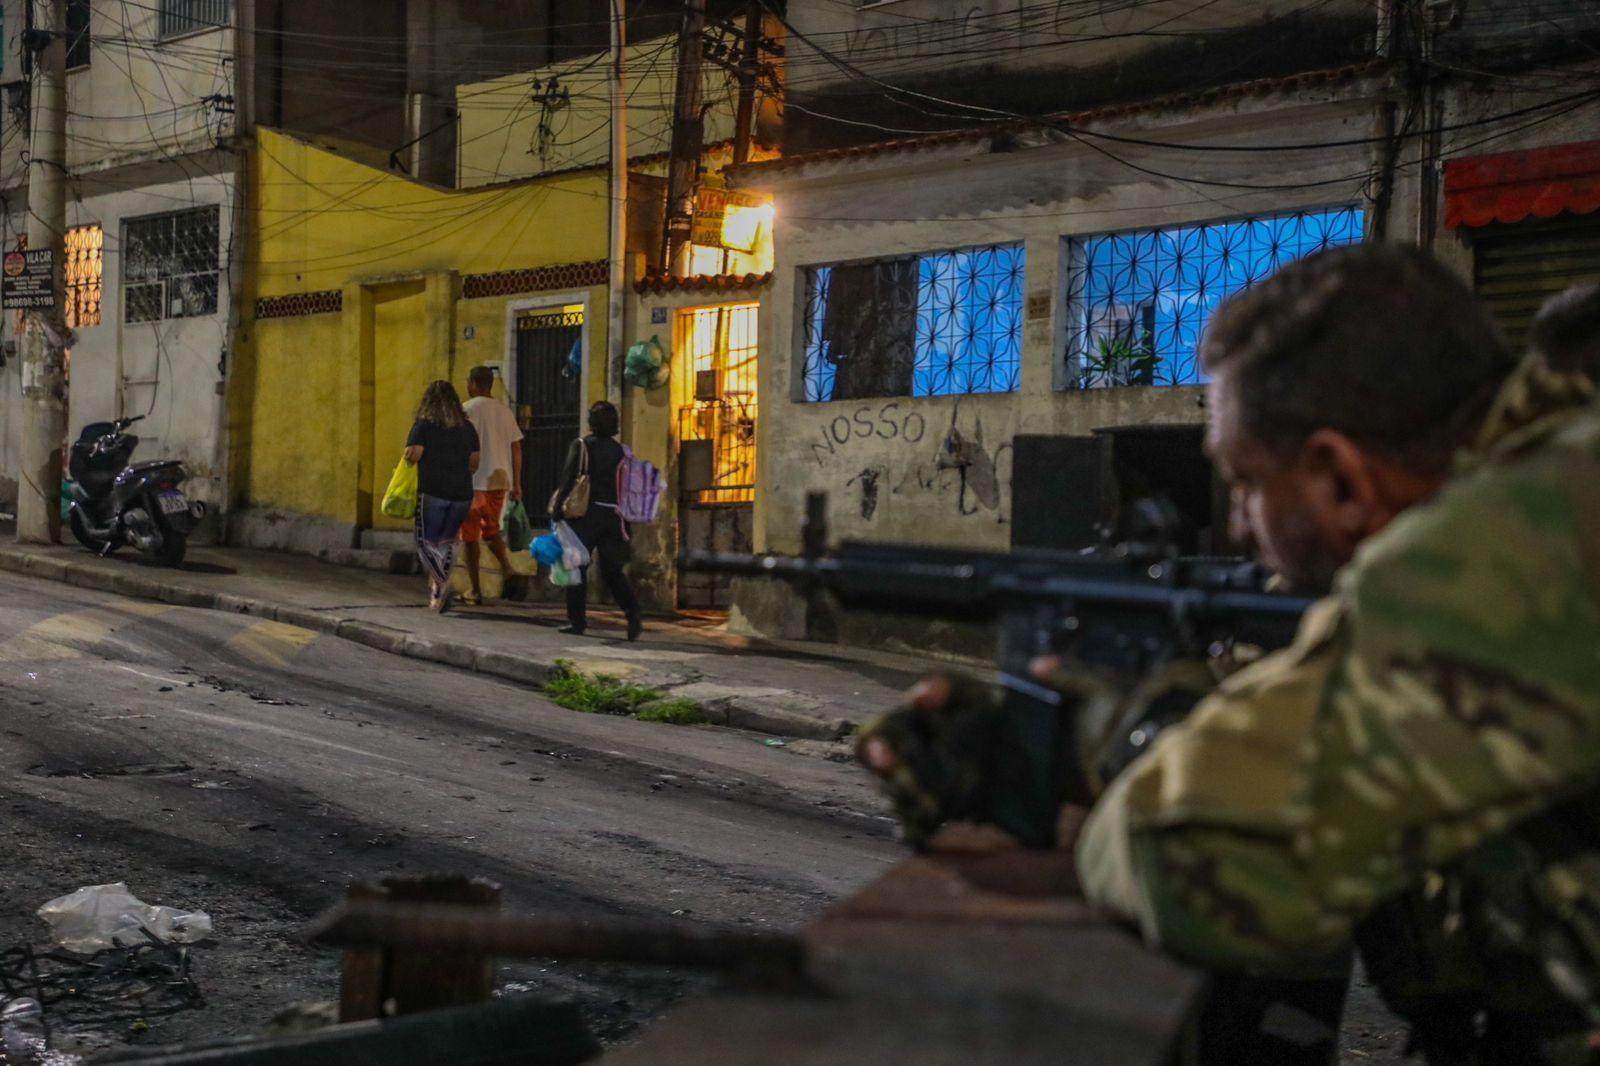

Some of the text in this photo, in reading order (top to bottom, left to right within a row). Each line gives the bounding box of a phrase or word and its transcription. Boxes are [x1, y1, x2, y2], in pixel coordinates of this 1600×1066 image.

[27, 251, 52, 263] VILA CAR
[811, 403, 926, 468] NOSSO
